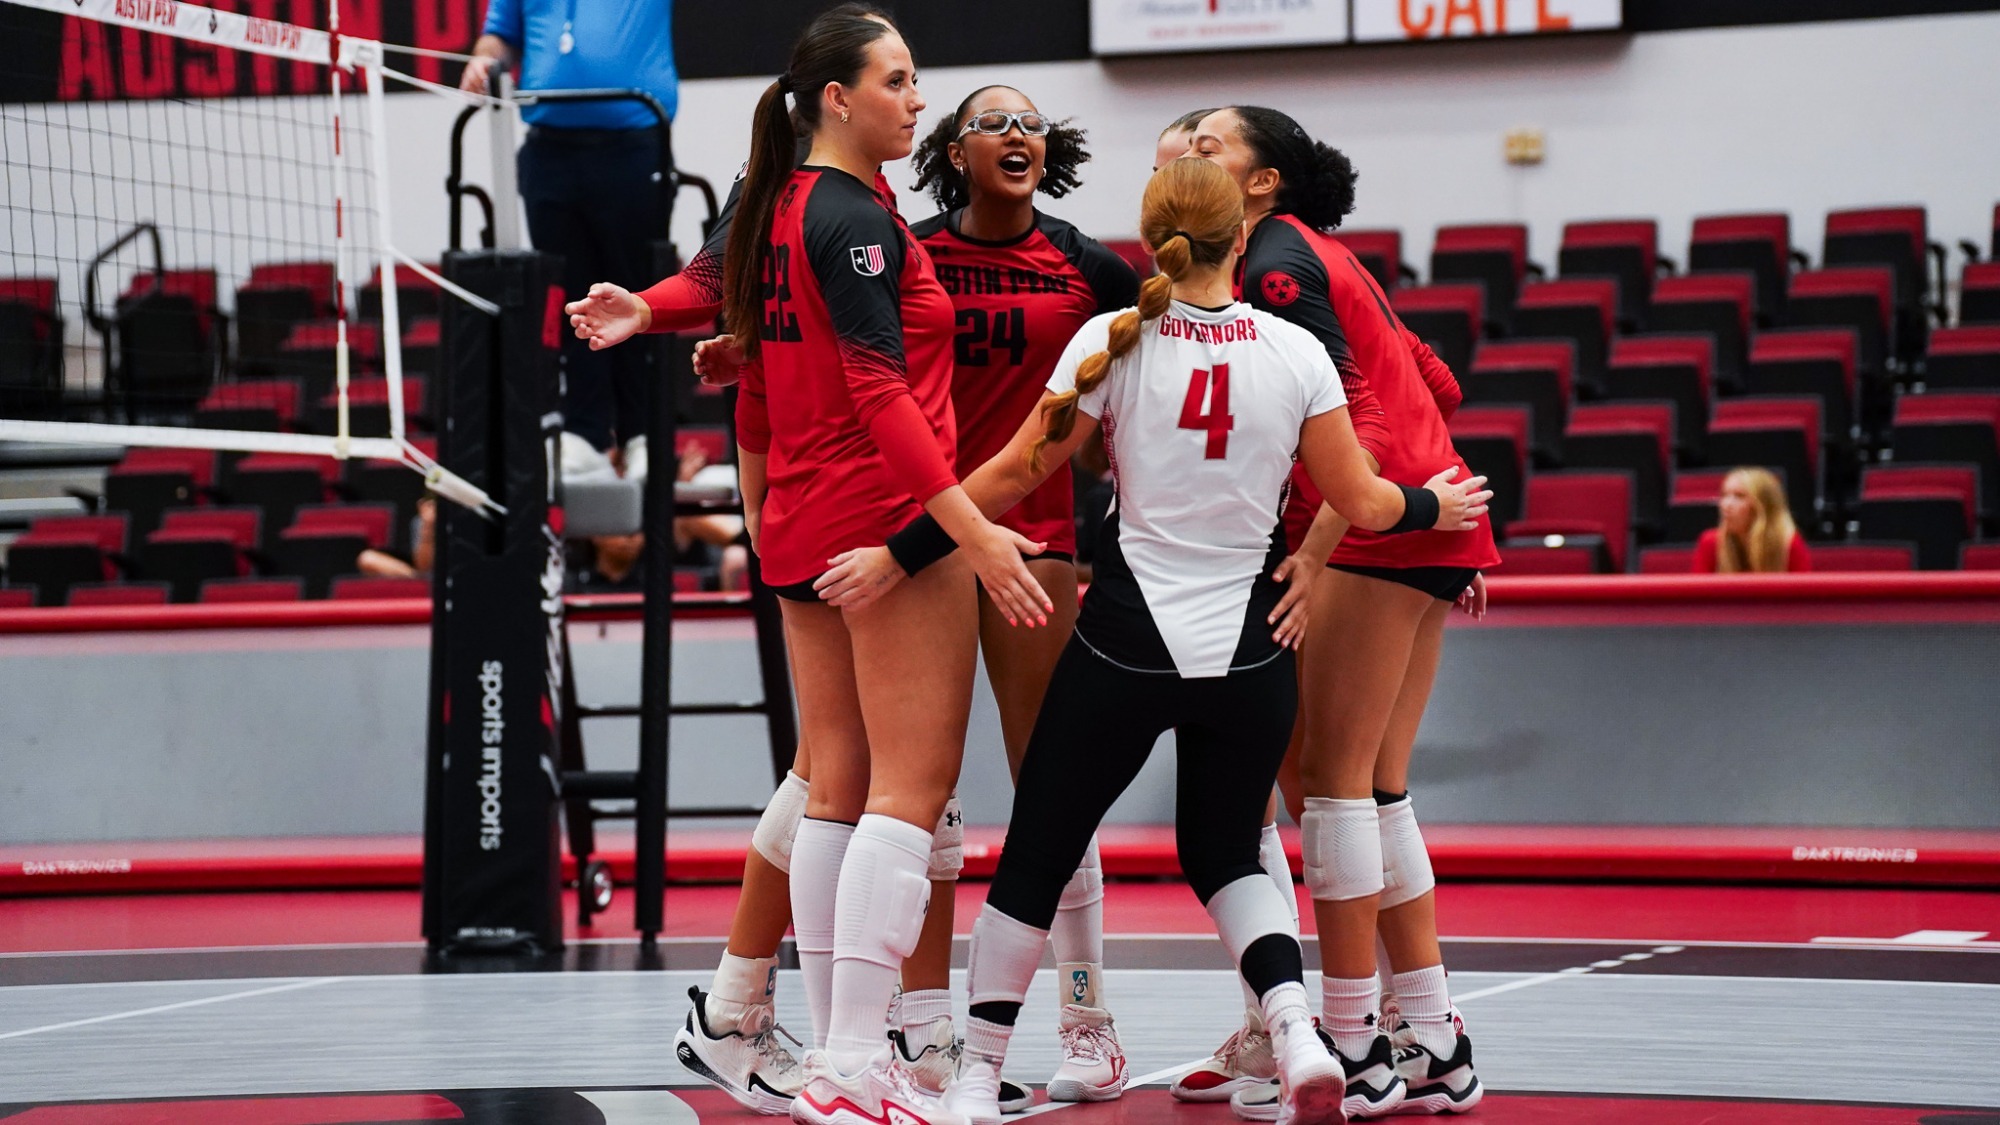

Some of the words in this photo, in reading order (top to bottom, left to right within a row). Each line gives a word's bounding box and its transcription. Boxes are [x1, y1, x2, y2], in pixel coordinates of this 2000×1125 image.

[760, 241, 803, 342] 22
[936, 265, 1002, 295] STIN
[955, 307, 1028, 367] 24
[1160, 313, 1257, 345] GOVERNORS
[1177, 362, 1234, 461] 4
[478, 660, 505, 745] sports
[477, 746, 504, 850] imports
